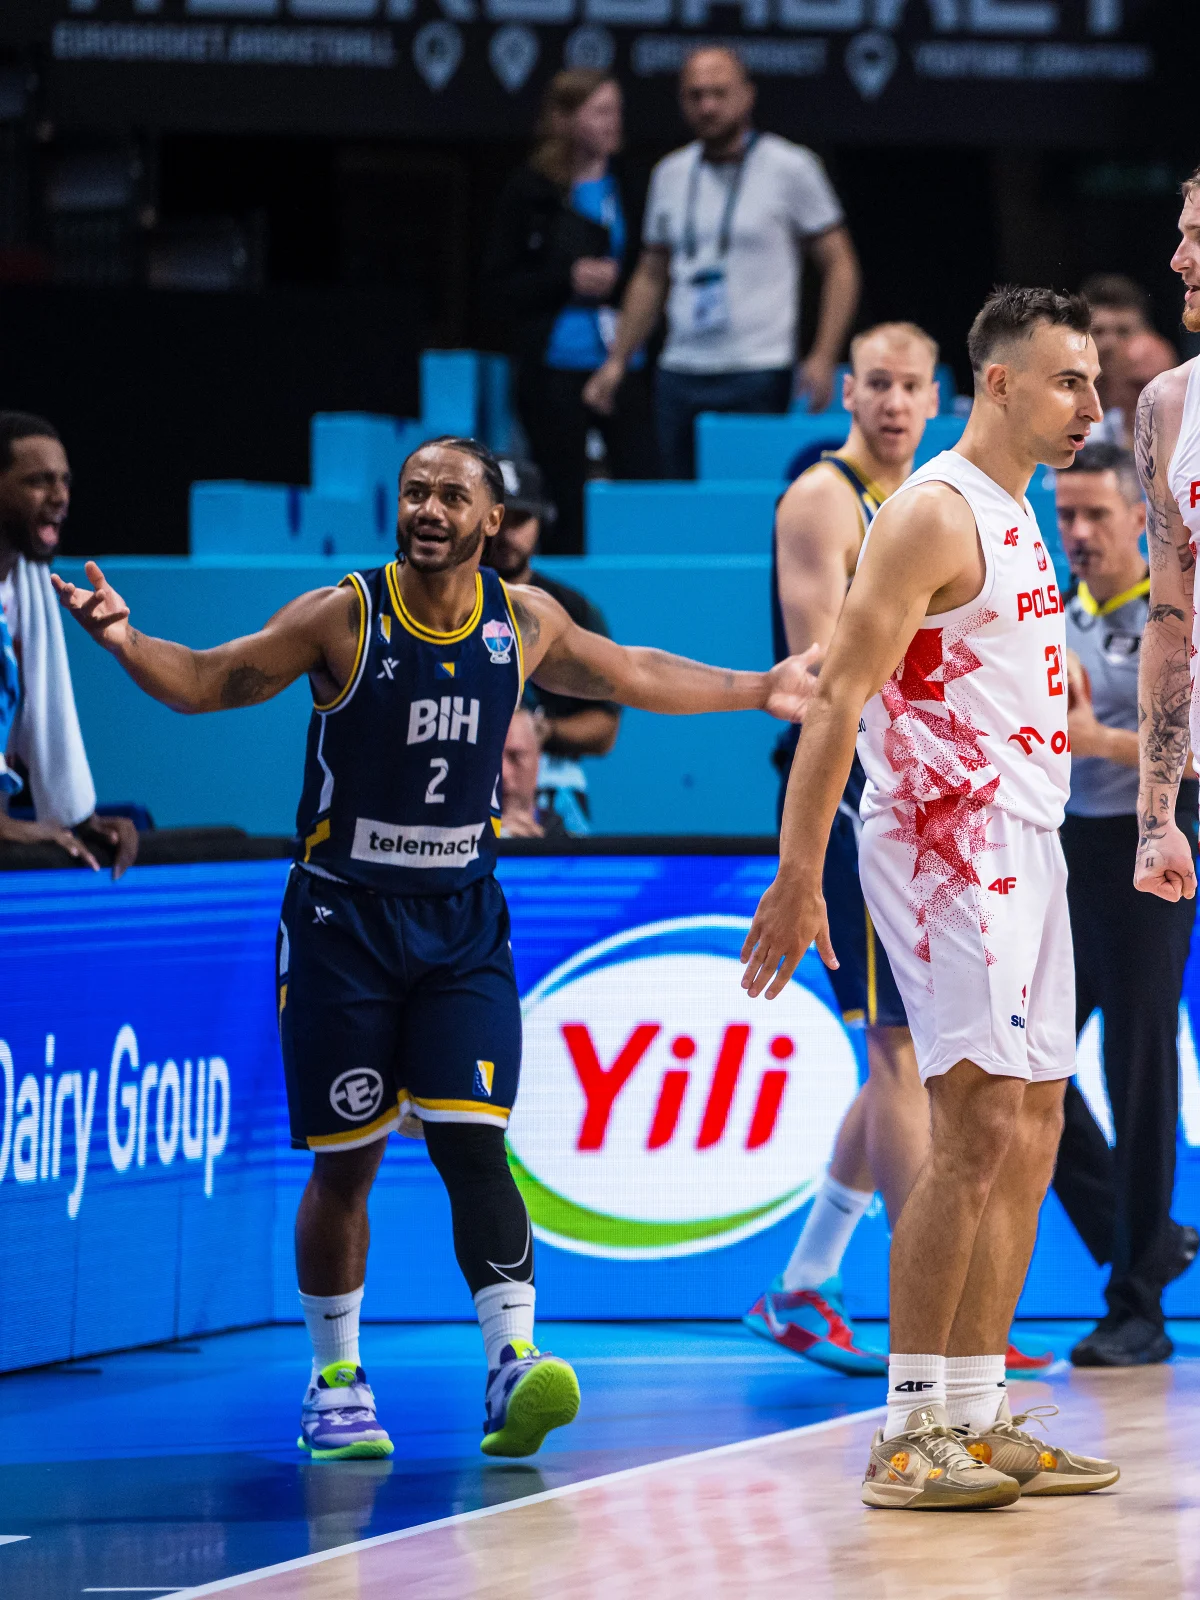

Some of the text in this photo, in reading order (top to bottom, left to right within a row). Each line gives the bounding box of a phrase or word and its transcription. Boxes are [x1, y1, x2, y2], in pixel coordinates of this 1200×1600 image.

[406, 696, 481, 746] BIH
[425, 757, 449, 804] 2
[107, 1022, 231, 1199] Group
[560, 1021, 796, 1153] Yili
